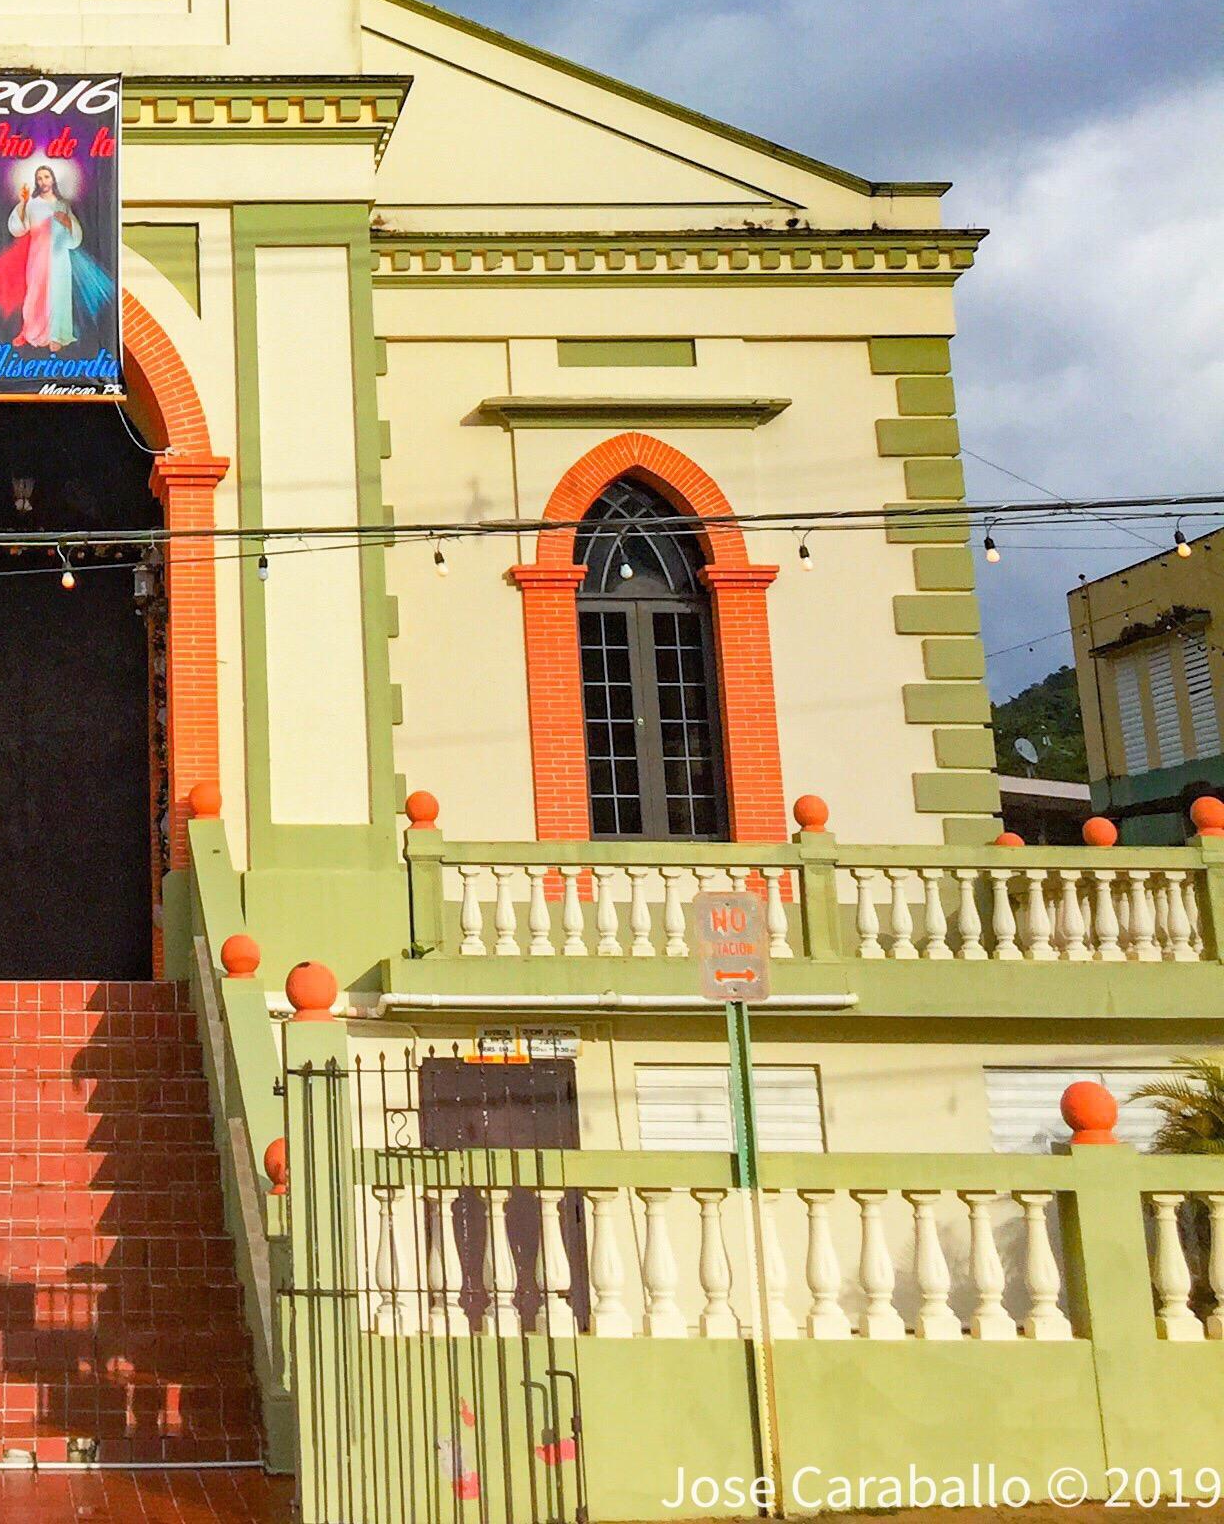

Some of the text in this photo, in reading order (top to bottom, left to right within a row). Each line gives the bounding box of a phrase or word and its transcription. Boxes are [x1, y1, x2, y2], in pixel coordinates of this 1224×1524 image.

[47, 125, 78, 158] de
[90, 126, 117, 158] la
[711, 907, 747, 933] NO
